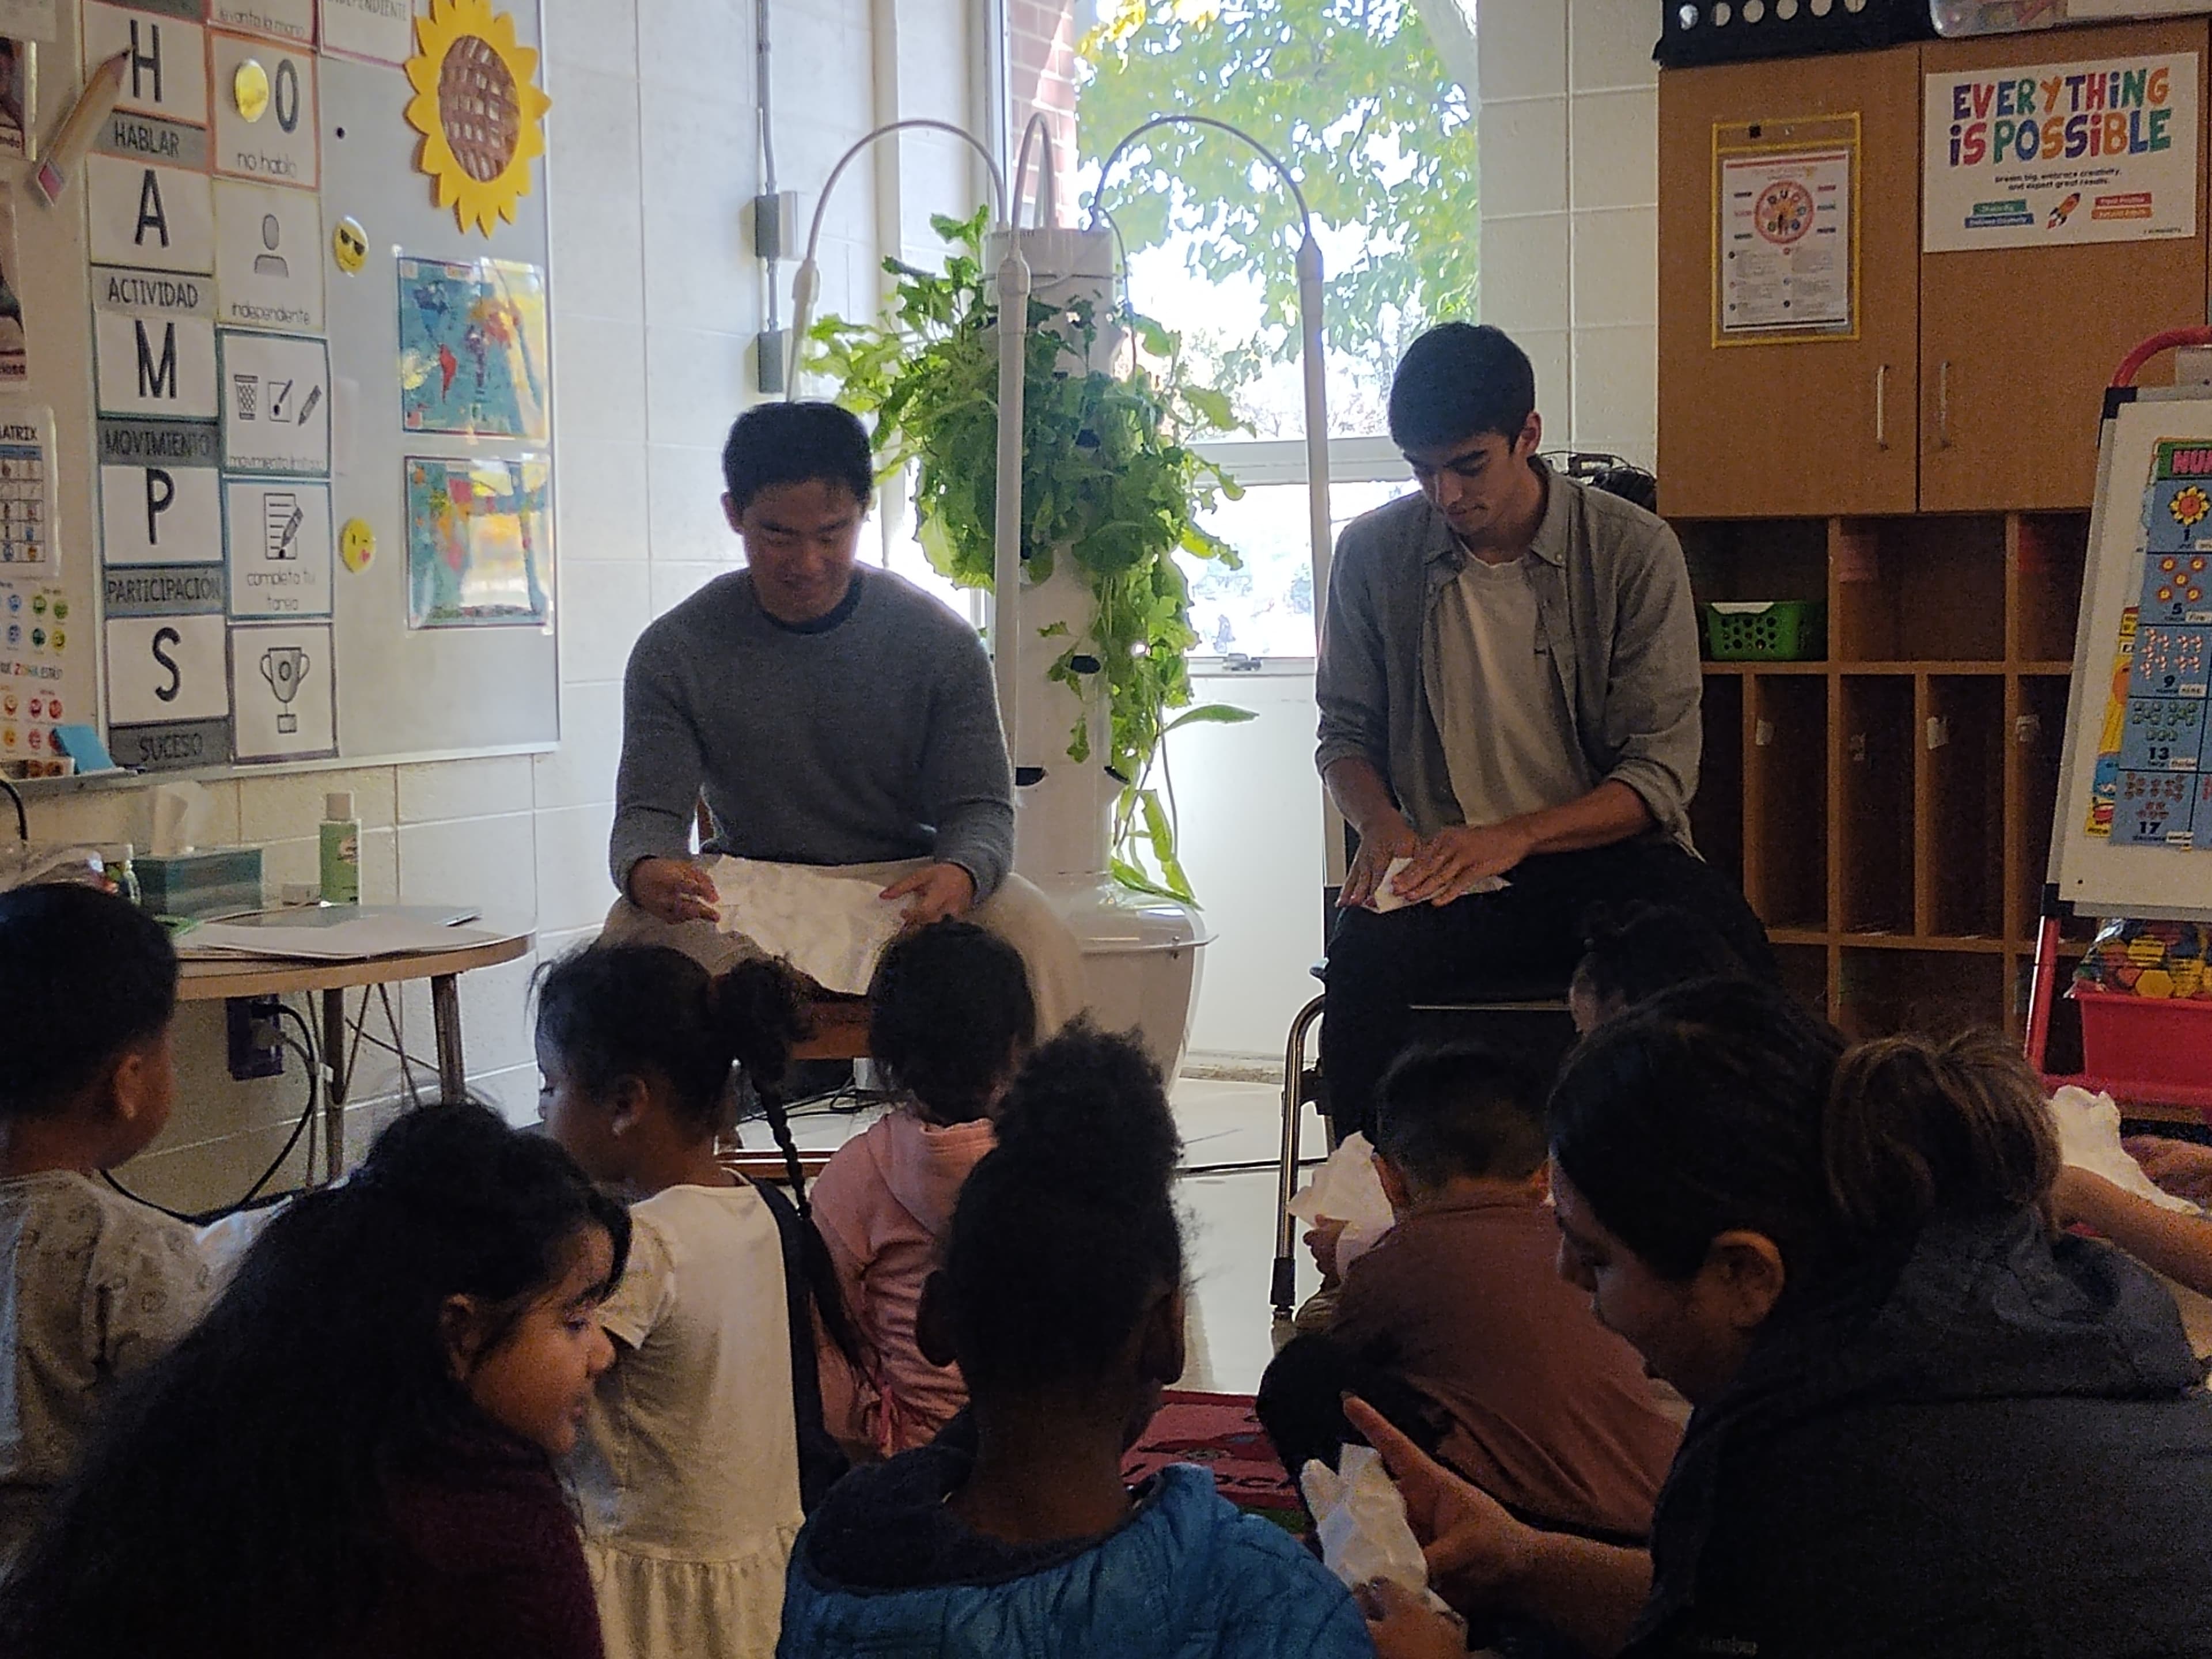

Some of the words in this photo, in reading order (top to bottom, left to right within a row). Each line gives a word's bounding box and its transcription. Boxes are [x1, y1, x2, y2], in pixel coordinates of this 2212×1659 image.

[131, 19, 162, 103] H
[115, 120, 180, 158] HABLAR
[237, 152, 257, 171] no
[134, 169, 170, 249] A
[108, 277, 199, 308] ACTIVIDAD
[135, 320, 178, 399] M
[104, 429, 211, 457] MOVIMIENTO
[146, 468, 175, 545] P
[107, 569, 222, 605] PARTICIPACIÓN
[2172, 603, 2183, 615] 5
[151, 626, 182, 703] S
[2164, 675, 2176, 688] 9
[139, 732, 203, 762] SUCESO
[2149, 747, 2170, 760] 13
[2139, 821, 2161, 835] 17
